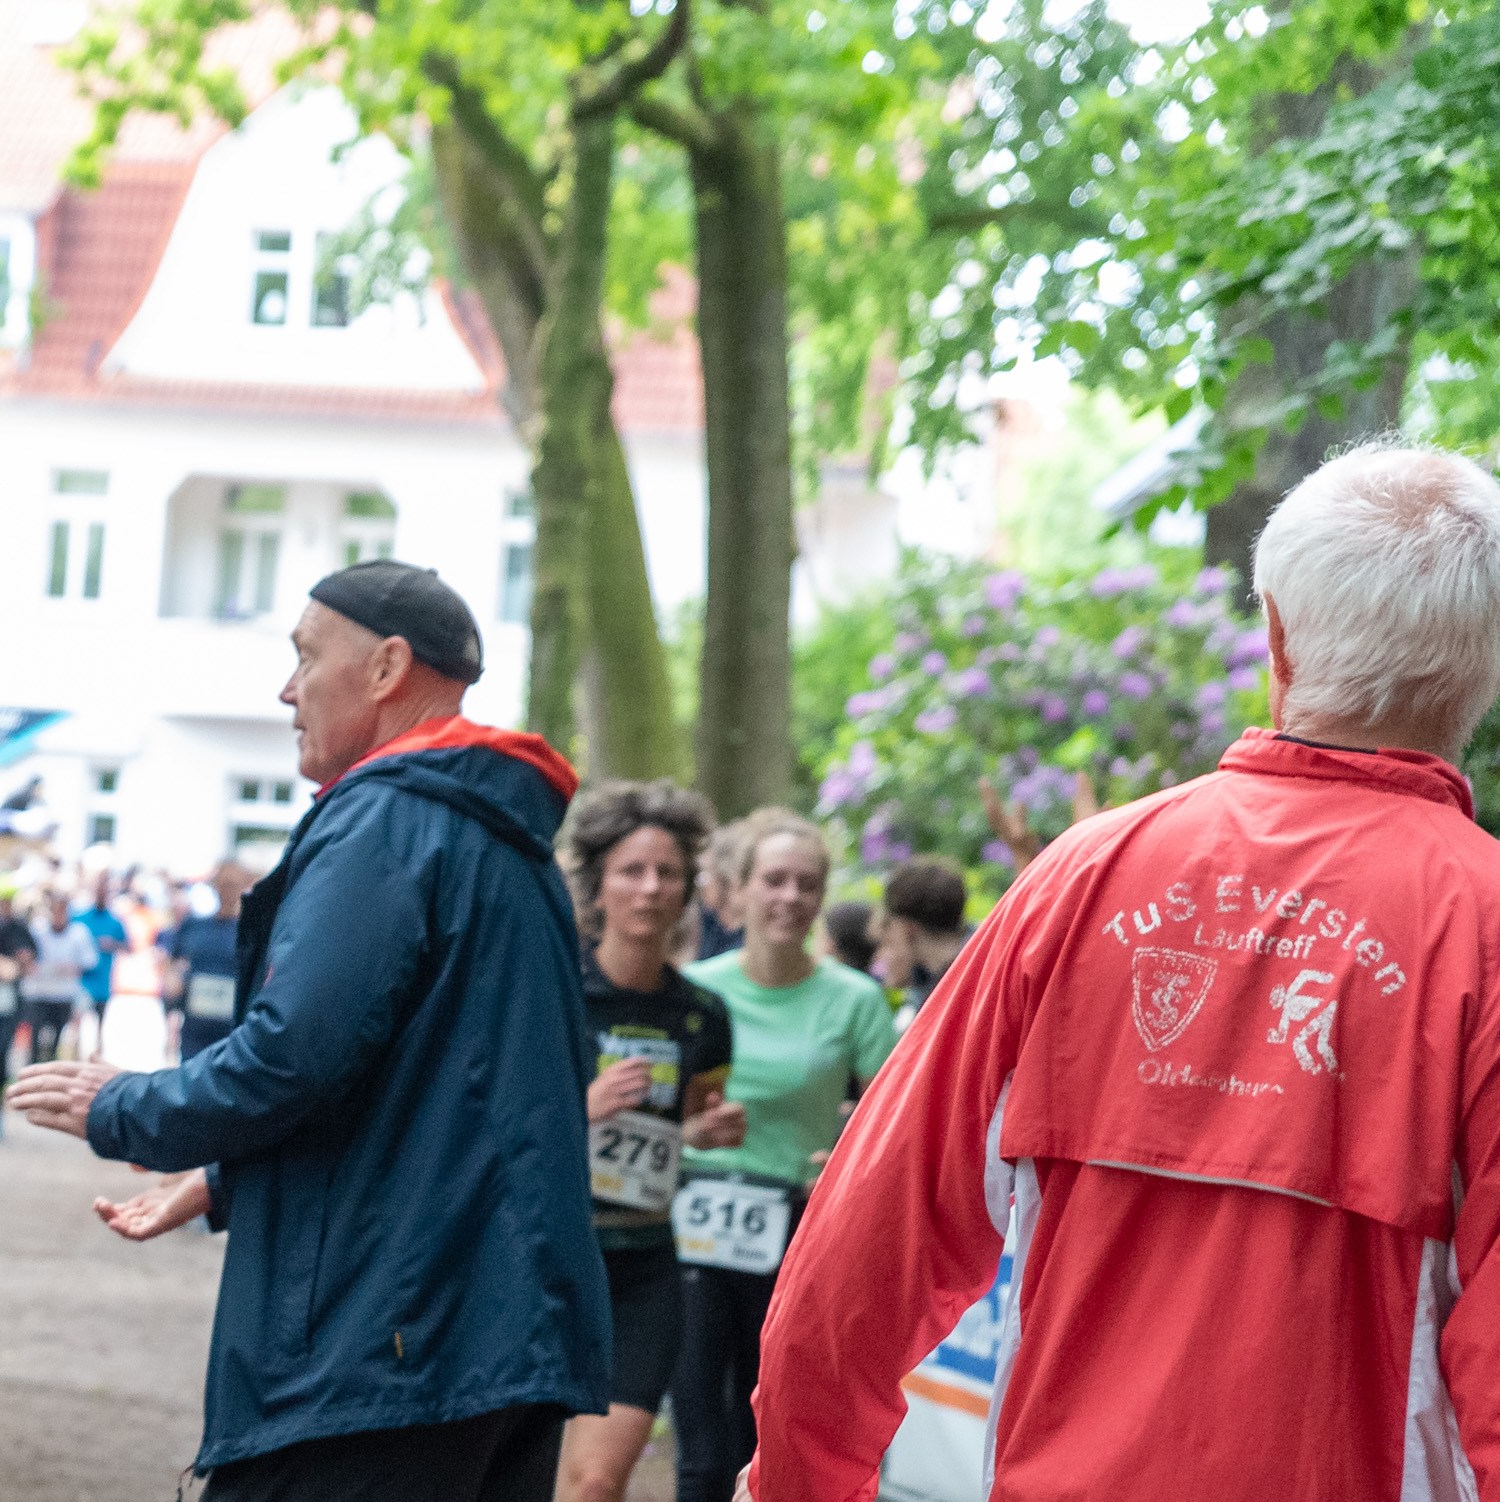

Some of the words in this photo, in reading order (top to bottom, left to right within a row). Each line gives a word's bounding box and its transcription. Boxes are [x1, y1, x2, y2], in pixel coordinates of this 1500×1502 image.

[1102, 882, 1198, 946] TuS
[1214, 874, 1407, 997] Eversten
[1193, 922, 1317, 959] Lauftreff
[597, 1128, 670, 1174] 279
[687, 1196, 768, 1235] 516
